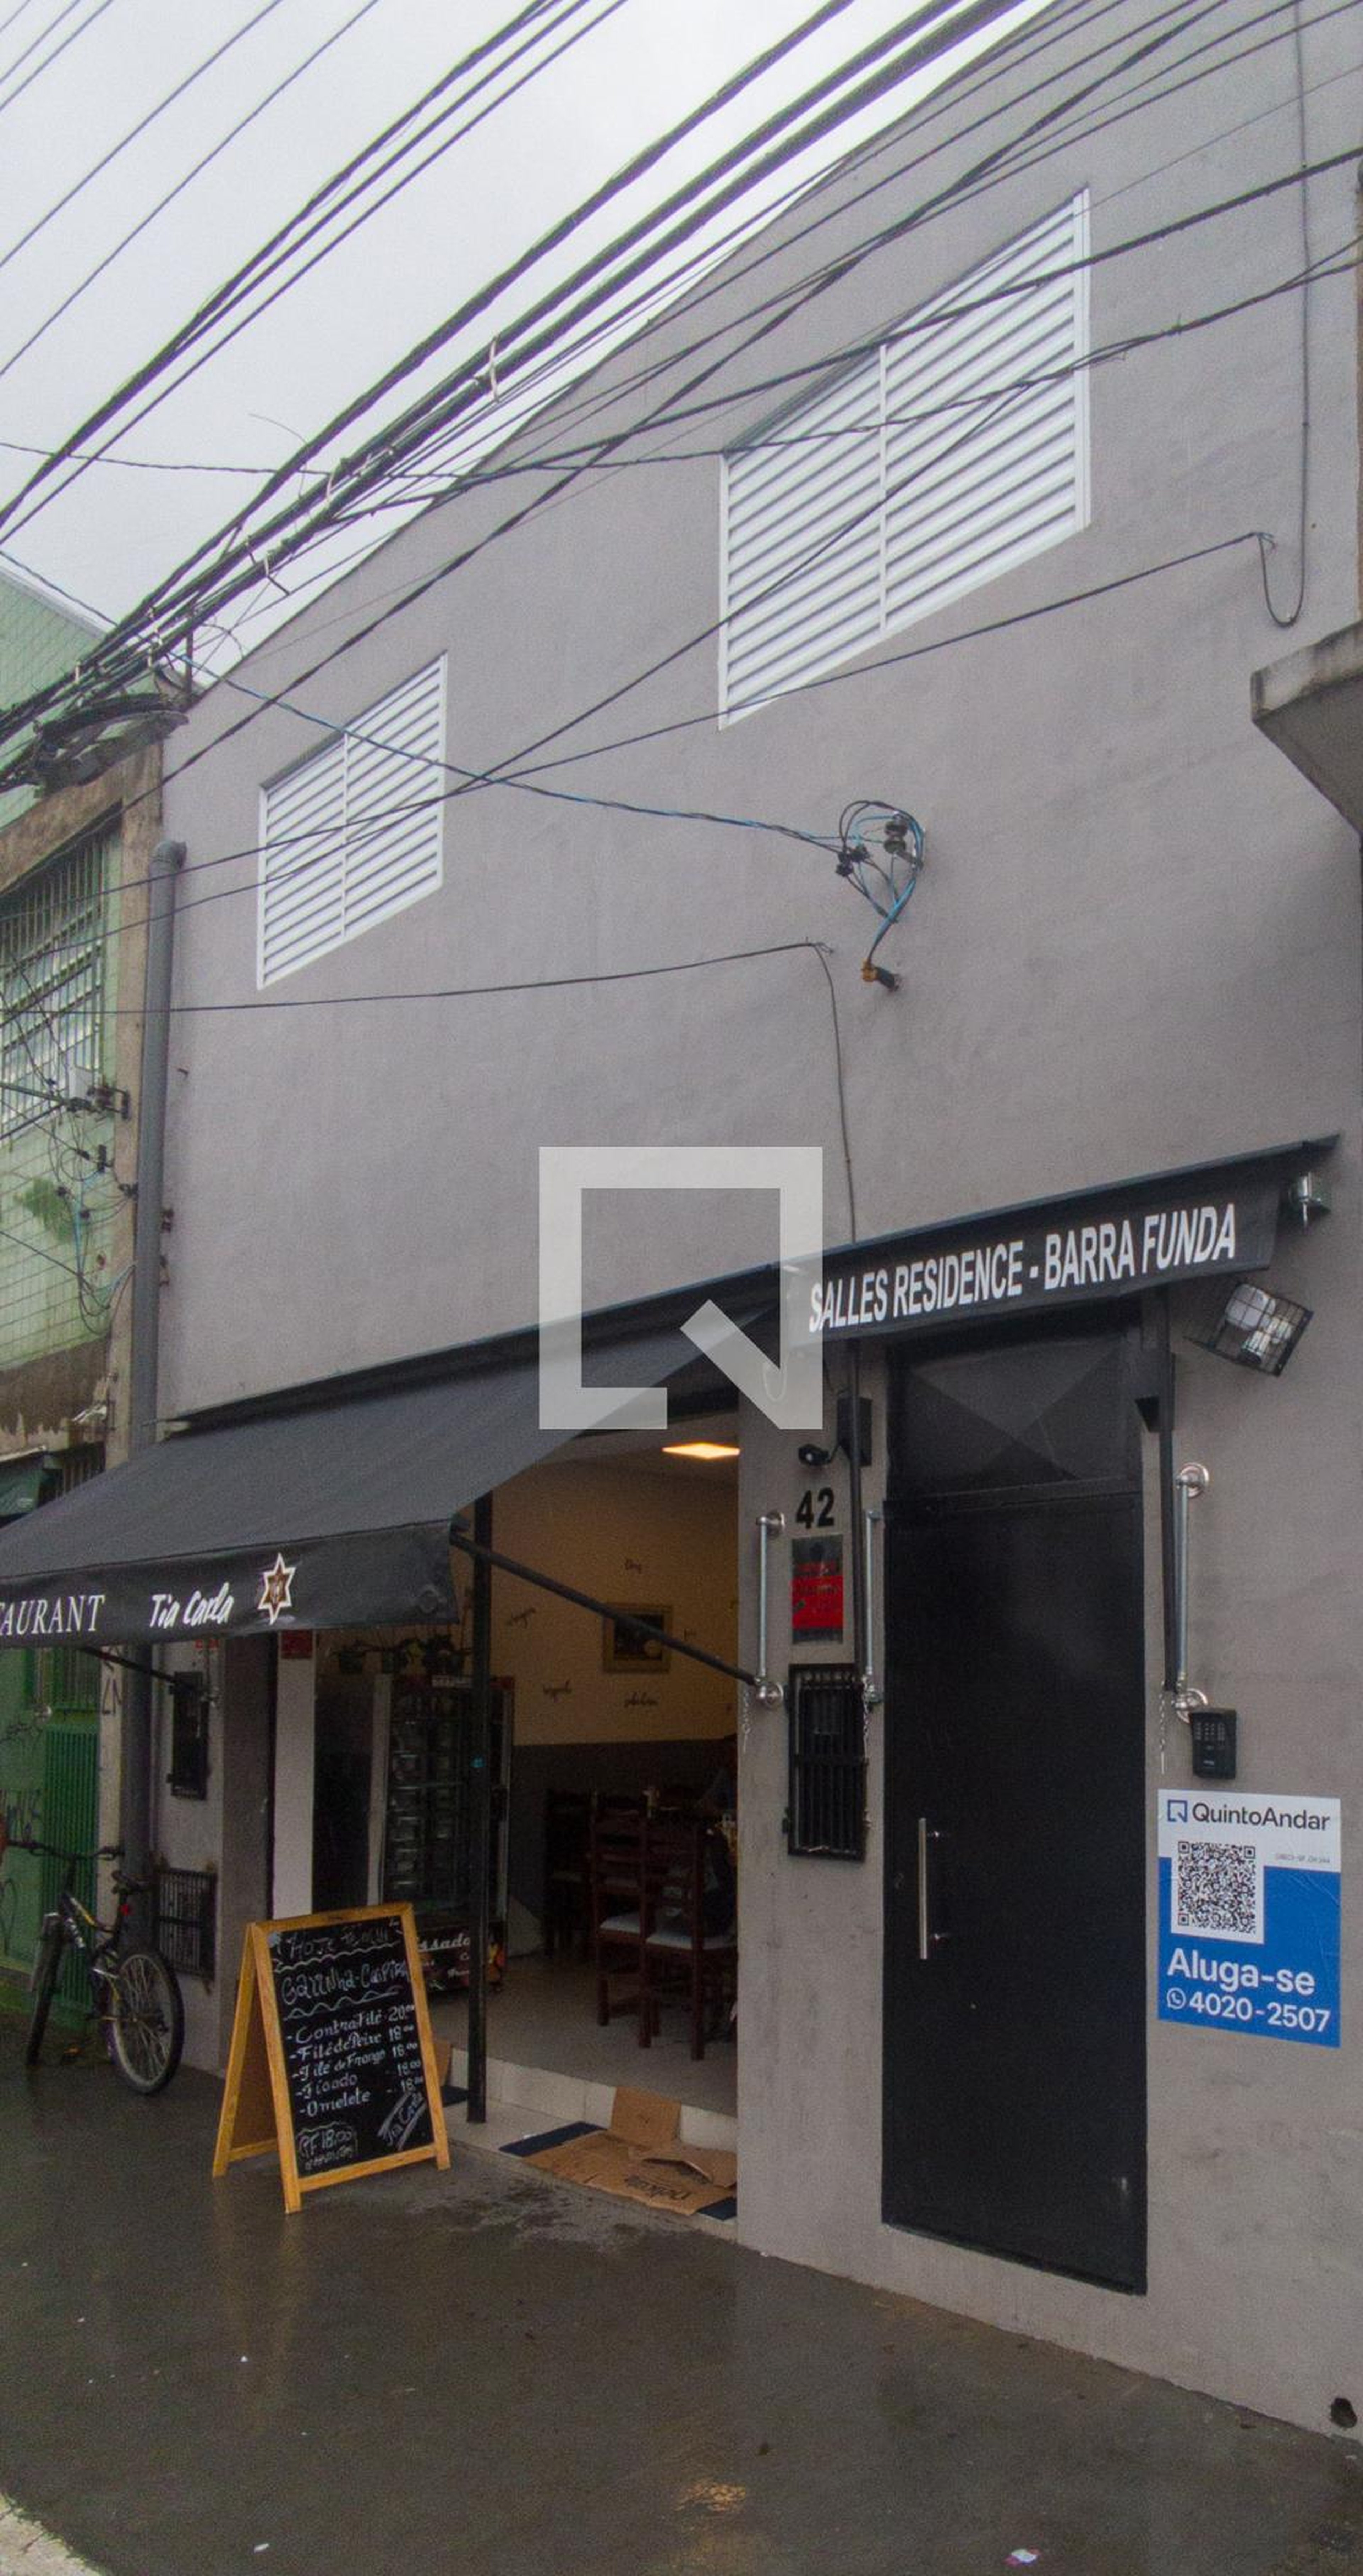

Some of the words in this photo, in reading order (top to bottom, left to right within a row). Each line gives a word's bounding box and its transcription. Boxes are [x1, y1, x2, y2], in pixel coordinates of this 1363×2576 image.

[809, 1269, 888, 1332] SALLES
[893, 1241, 1023, 1317] RESIDENCE
[1030, 1266, 1039, 1278] -
[1044, 1220, 1135, 1290] BARRA
[1142, 1203, 1235, 1274] FUNDA
[796, 1487, 835, 1530] 42
[0, 1594, 105, 1636] AURANT
[149, 1594, 180, 1629] Tia
[183, 1582, 234, 1626] Carla
[1192, 1802, 1330, 1831] QuintoAndar
[1167, 1947, 1315, 1996] Aluga-se
[1189, 1991, 1331, 2032] 4020-2507
